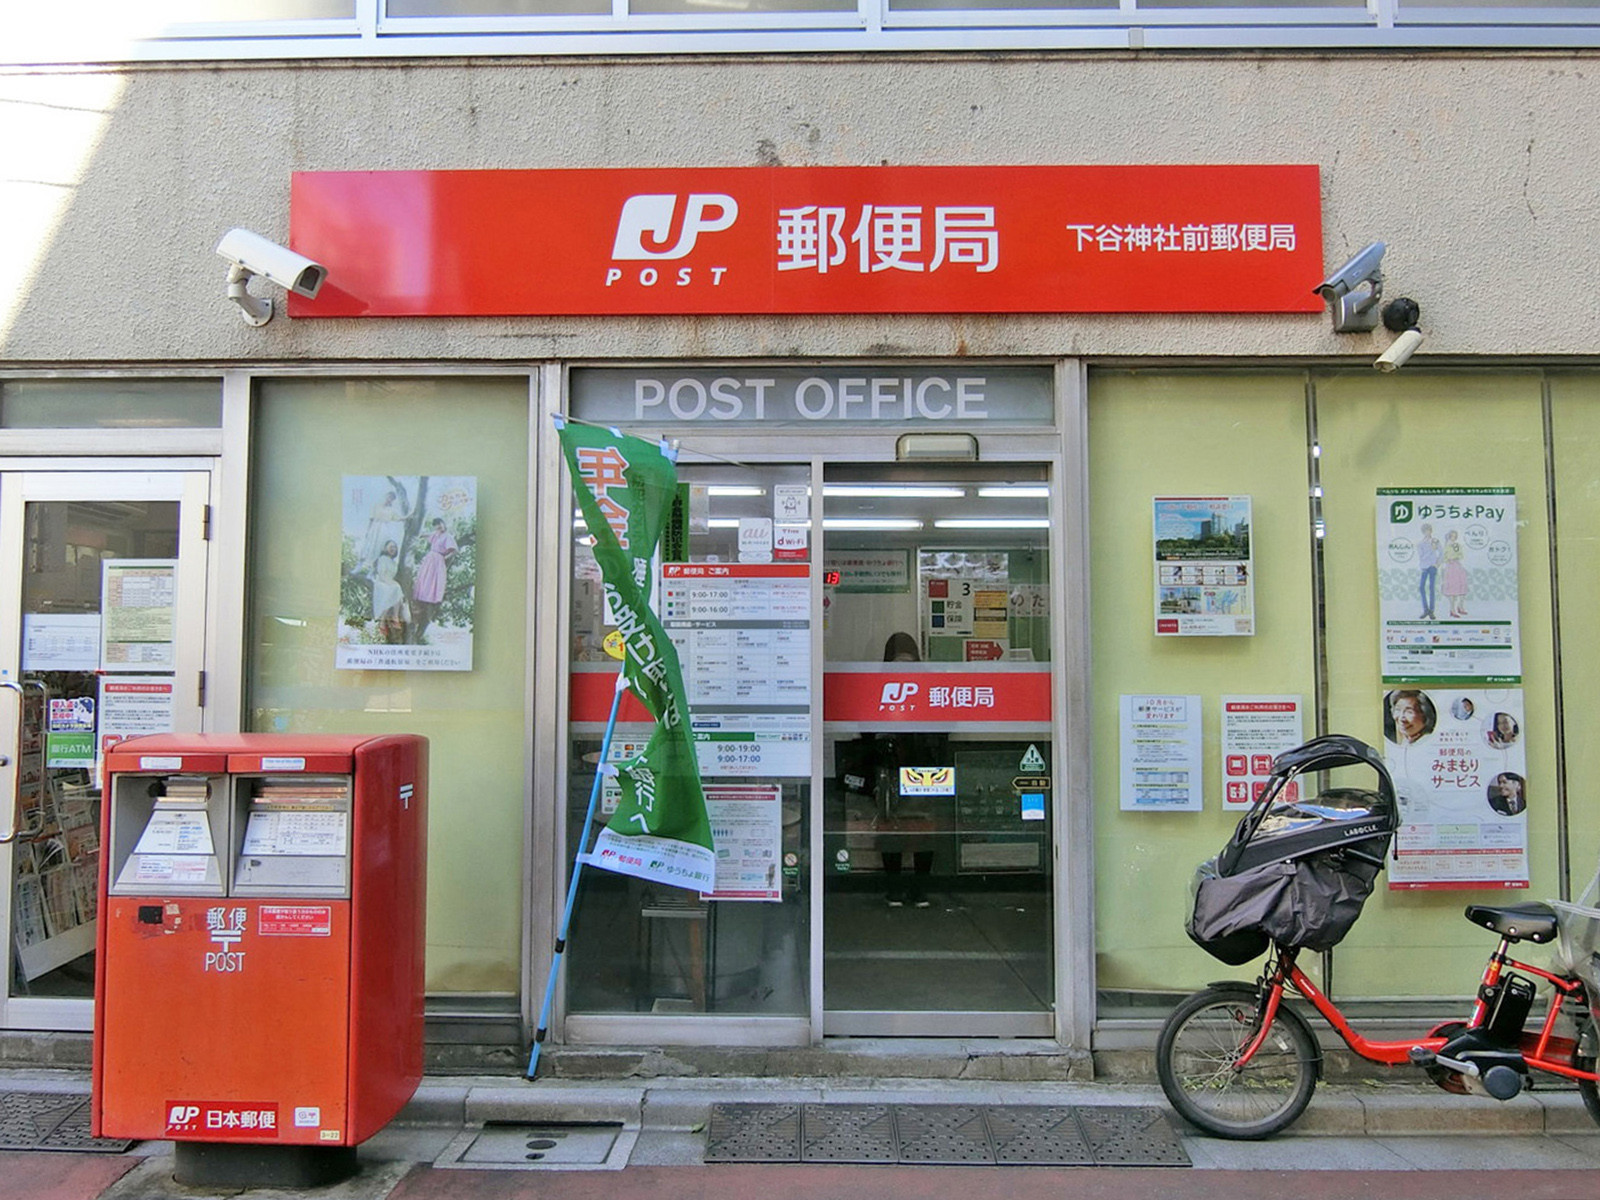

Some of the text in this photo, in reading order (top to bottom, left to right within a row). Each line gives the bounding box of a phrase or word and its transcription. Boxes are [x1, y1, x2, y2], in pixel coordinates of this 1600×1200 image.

[610, 193, 739, 261] JP
[776, 204, 1001, 275] 郵便局
[1065, 222, 1298, 254] 下谷神社前郵便局
[605, 266, 728, 288] POST
[634, 376, 989, 422] POST OFFICE
[1418, 504, 1505, 522] ゆうちょPay
[825, 572, 839, 585] 13
[962, 582, 971, 597] 3
[880, 682, 919, 704] JP
[928, 686, 995, 708] 郵便局
[717, 744, 761, 752] 9:00-19:00
[717, 755, 761, 763] 9:00-17:00
[1431, 758, 1479, 773] みまもり
[1430, 773, 1481, 789] サービス
[1343, 823, 1379, 837] LABOCLE
[618, 854, 642, 867] 郵便局
[666, 865, 710, 882] ゆうちょ銀行
[206, 906, 247, 931] 郵便
[204, 952, 246, 972] POST
[206, 1109, 276, 1129] 日本郵便
